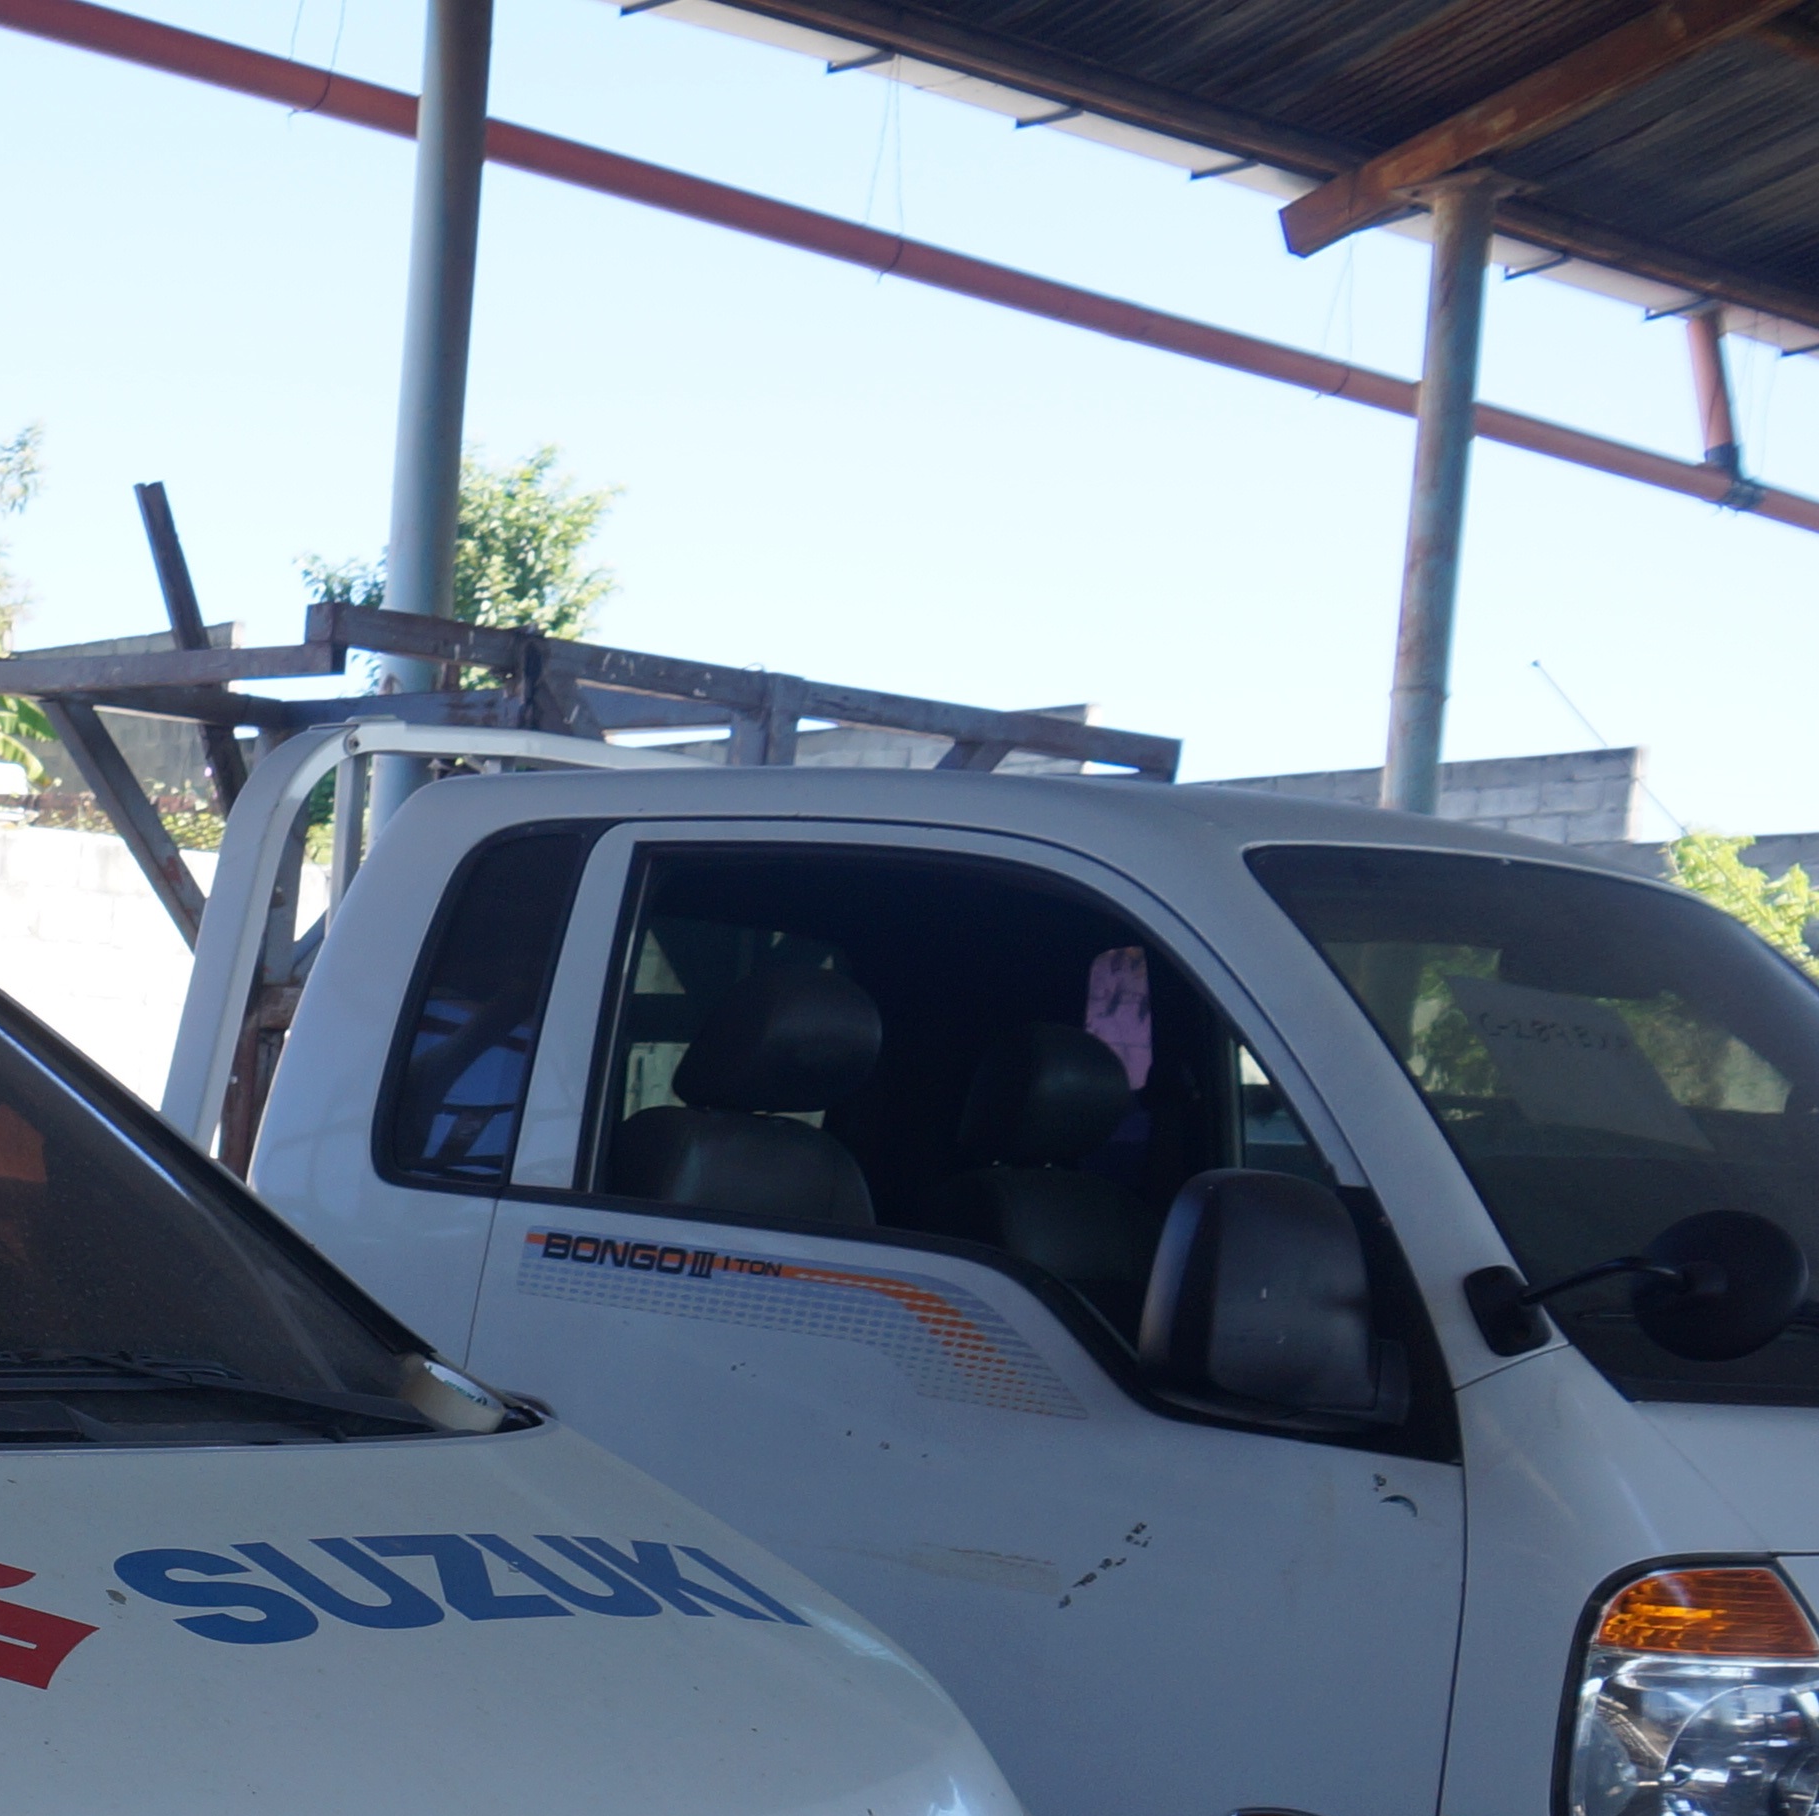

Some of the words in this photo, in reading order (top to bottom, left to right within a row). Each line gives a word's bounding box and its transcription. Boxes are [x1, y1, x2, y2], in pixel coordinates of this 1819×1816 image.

[542, 1231, 688, 1275] BONGO
[688, 1249, 717, 1279] III
[732, 1258, 783, 1277] TON
[113, 1533, 810, 1645] SUZUKI
